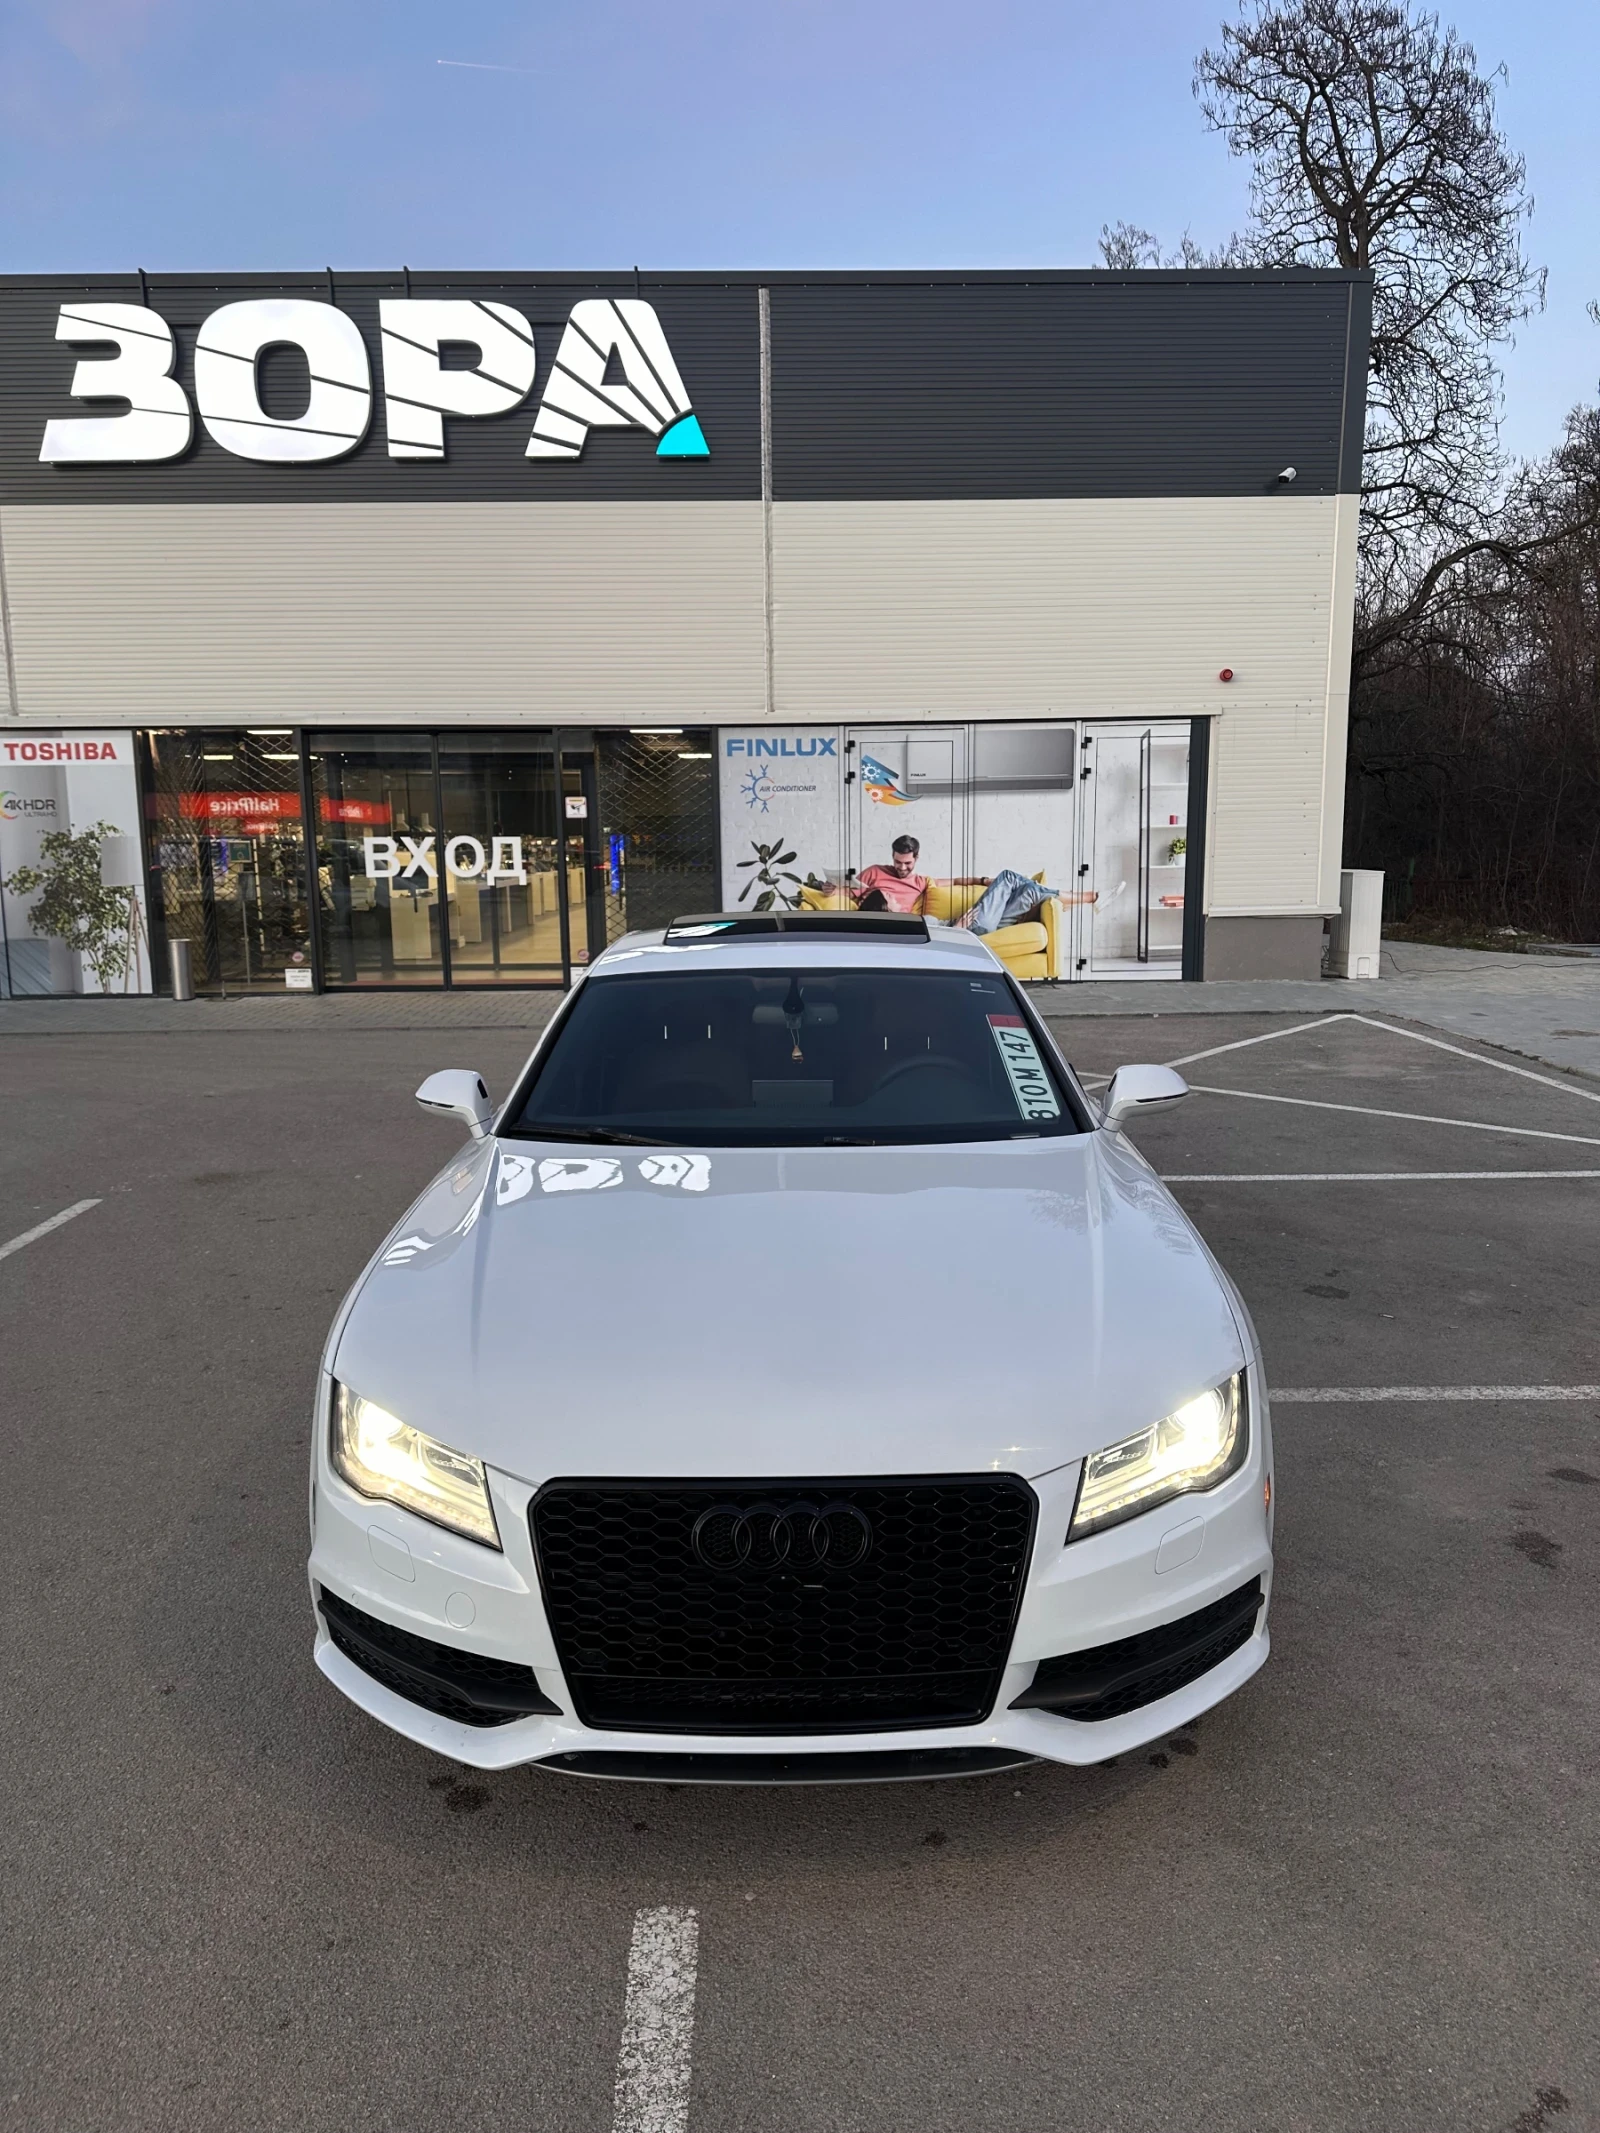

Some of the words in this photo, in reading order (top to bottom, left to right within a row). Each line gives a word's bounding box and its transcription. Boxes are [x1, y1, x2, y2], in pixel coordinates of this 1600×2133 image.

[38, 298, 711, 463] ЗОРА
[3, 742, 117, 761] TOSHIBA
[726, 738, 837, 757] FINLUX
[363, 835, 527, 886] ВХОД
[999, 1031, 1035, 1061] 147
[1020, 1085, 1057, 1119] 810
